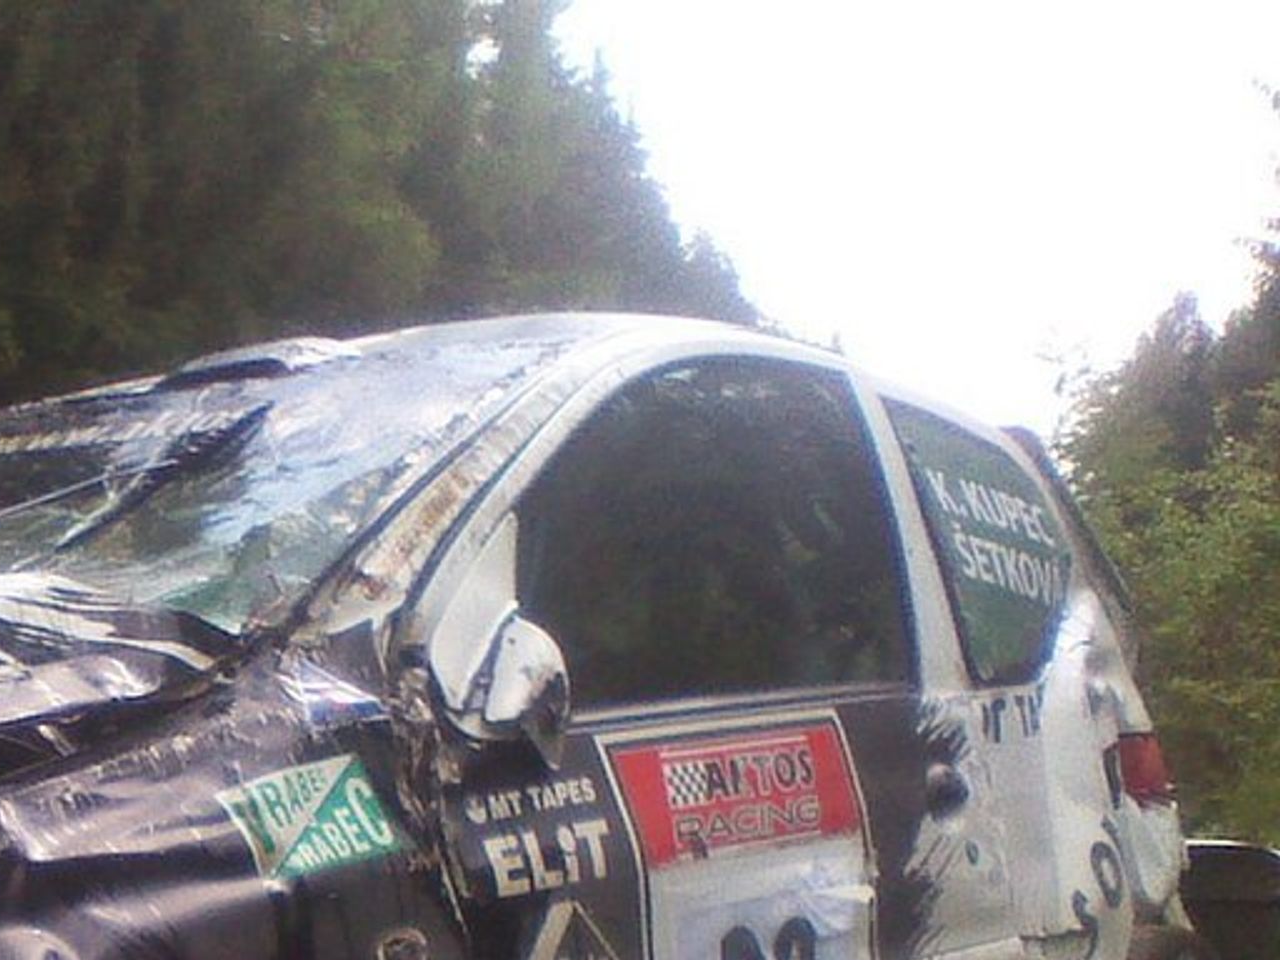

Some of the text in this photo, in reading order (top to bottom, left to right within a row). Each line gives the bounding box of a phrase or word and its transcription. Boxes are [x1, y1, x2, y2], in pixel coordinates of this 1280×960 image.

[959, 479, 1055, 547] KUPEC
[526, 776, 597, 811] TAPES
[674, 795, 822, 850] RACING
